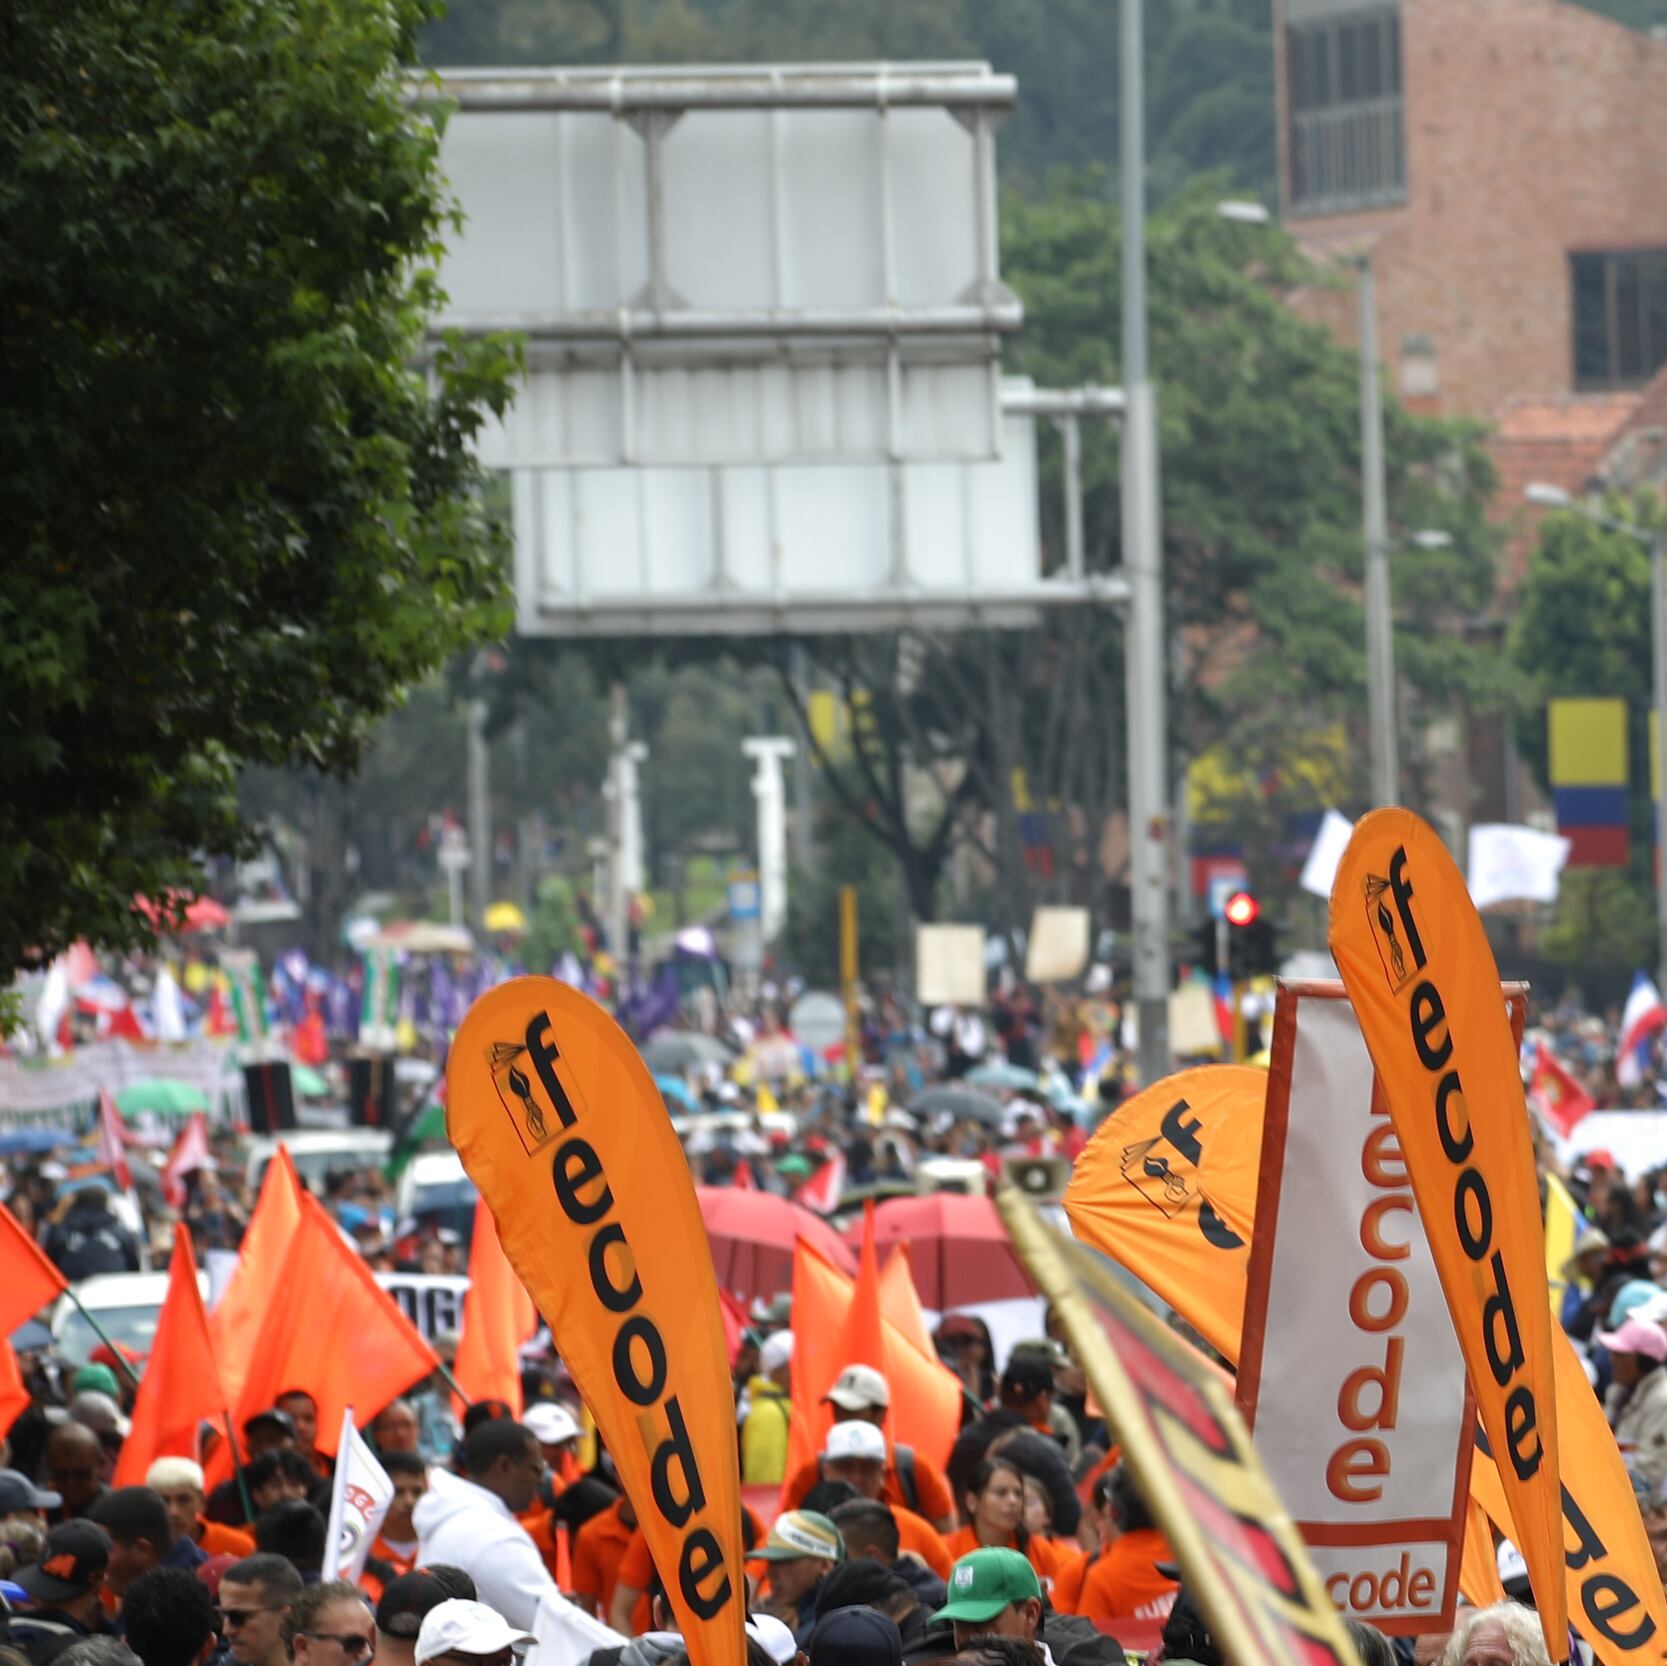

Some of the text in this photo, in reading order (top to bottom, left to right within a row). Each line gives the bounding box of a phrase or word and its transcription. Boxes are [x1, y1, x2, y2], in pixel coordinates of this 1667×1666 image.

[525, 1010, 733, 1621] fecode
[1326, 1068, 1413, 1503] ecode
[1387, 844, 1542, 1481] fecode
[1325, 1551, 1437, 1608] code
